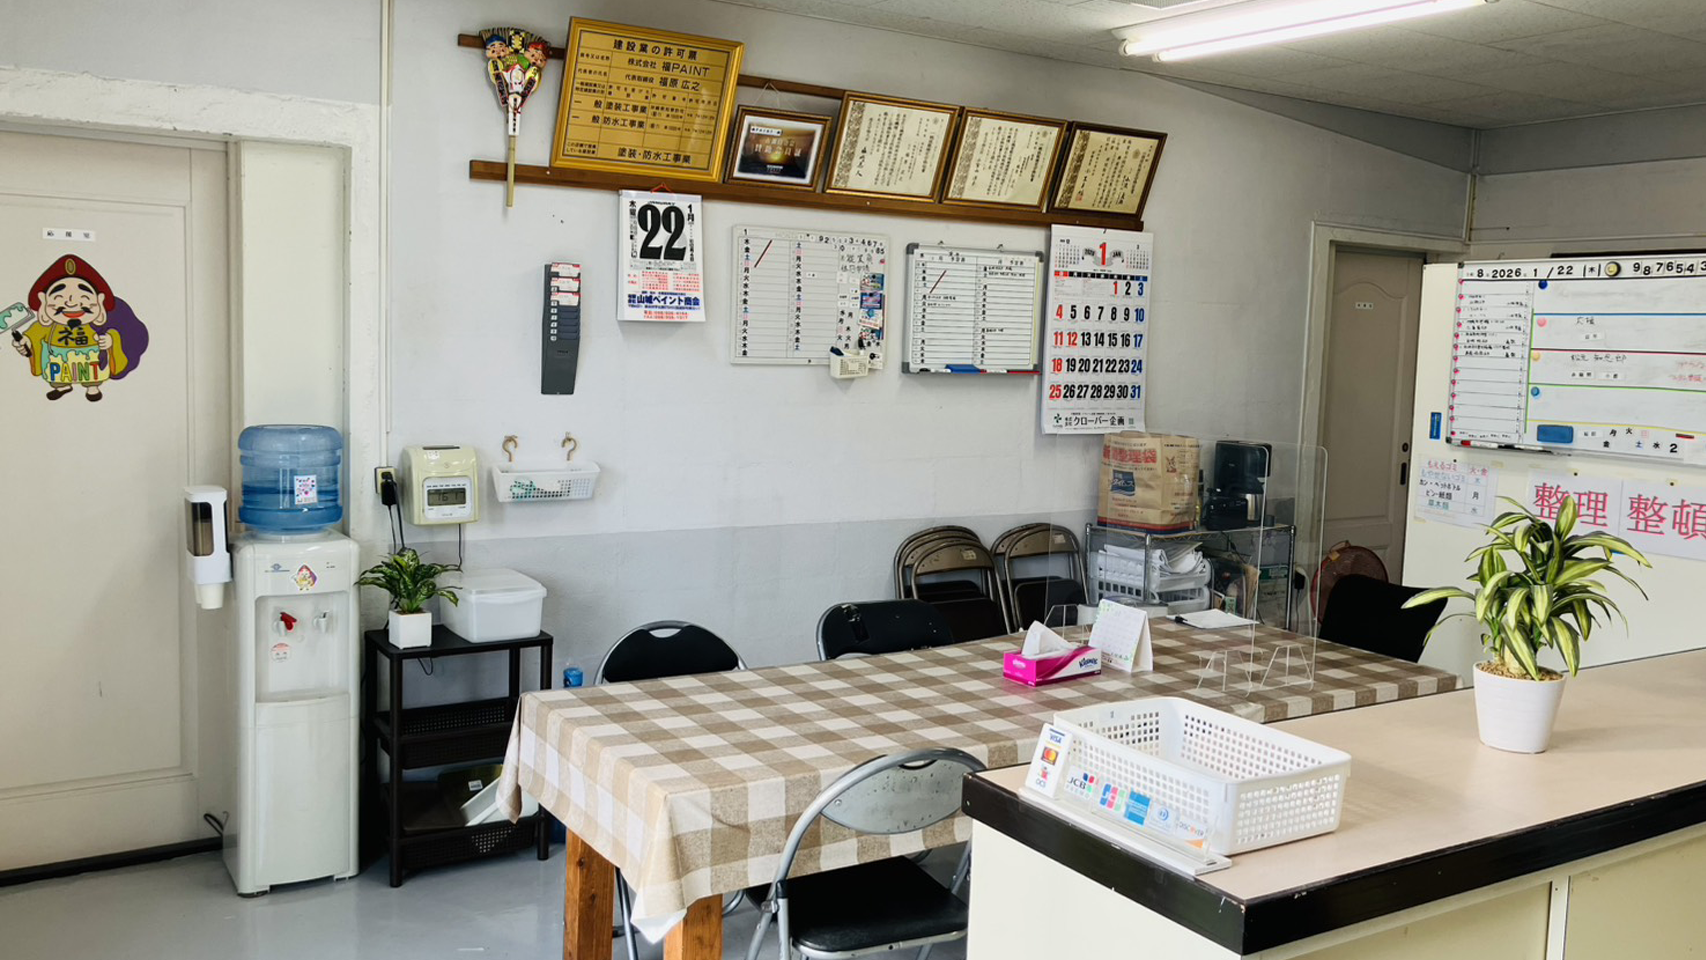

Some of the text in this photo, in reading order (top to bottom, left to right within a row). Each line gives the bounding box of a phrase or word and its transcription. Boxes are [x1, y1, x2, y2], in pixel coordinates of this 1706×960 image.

[613, 39, 698, 61] 建設業の許可票
[628, 58, 710, 77] 株式会社 福PAINT
[681, 81, 701, 92] 広之
[606, 102, 648, 114] 塗装工事業
[603, 117, 645, 129] 防水工事業
[618, 147, 692, 165] 塗装・防水工事業
[637, 204, 687, 261] 22
[1099, 242, 1107, 266] 1
[1476, 269, 1484, 278] 8
[1491, 267, 1522, 280] 2026
[1532, 268, 1538, 277] 1
[1557, 265, 1574, 275] 22
[1633, 262, 1641, 272] 9
[1643, 266, 1651, 276] 8
[1656, 262, 1663, 272] 7
[1666, 261, 1674, 271] 6
[1676, 263, 1684, 274] 5
[1686, 264, 1695, 273] 4
[1114, 281, 1144, 296] 1 2 3
[637, 294, 701, 306] 山城ペイント商会
[1056, 305, 1145, 323] 4 5 6 7 8 9 10
[1054, 332, 1143, 348] 11 12 13 14 15 16 17
[49, 362, 101, 382] PAINT
[1052, 358, 1143, 374] 18 19 20 21 22 23 24
[1049, 384, 1141, 400] 25 26 27 28 29 30 31
[1073, 415, 1125, 426] クローバー企画
[1669, 443, 1679, 454] 2
[1428, 460, 1457, 471] もえるゴミ
[1472, 492, 1479, 500] 月
[1533, 482, 1609, 528] 整理
[1049, 734, 1062, 743] VISA
[1067, 777, 1087, 790] JCB
